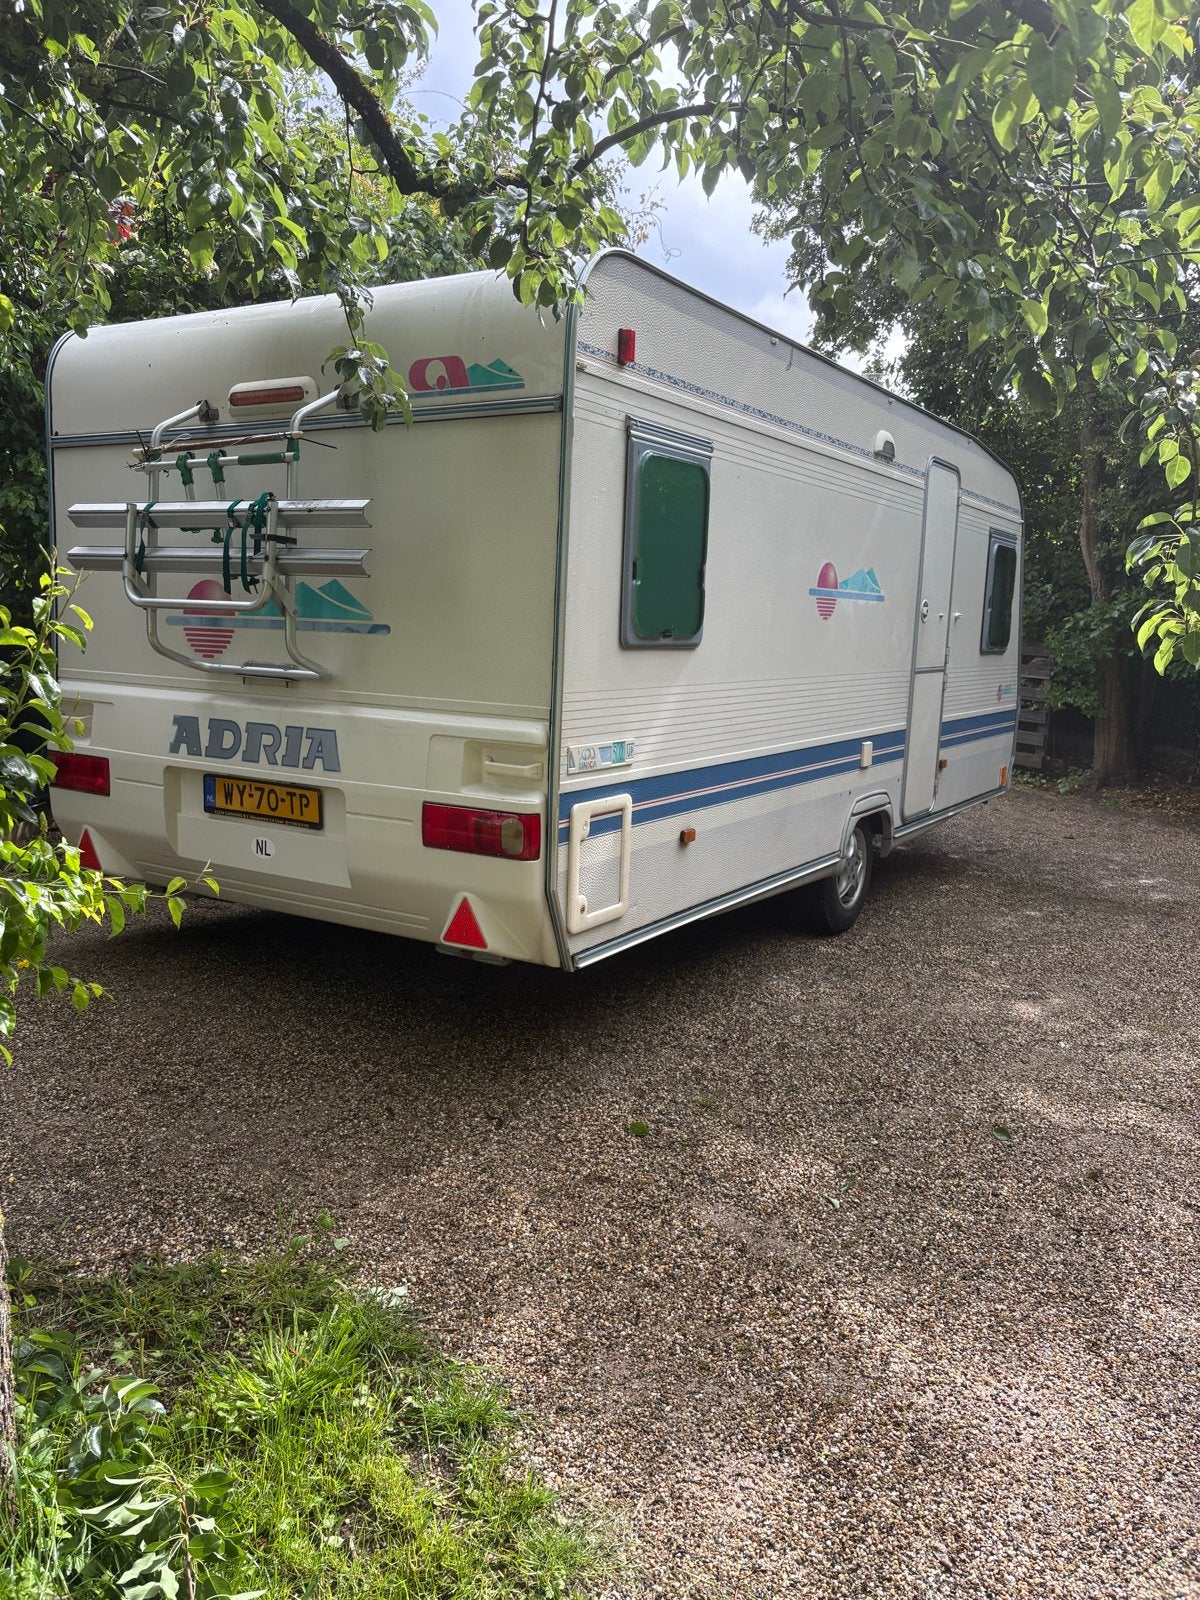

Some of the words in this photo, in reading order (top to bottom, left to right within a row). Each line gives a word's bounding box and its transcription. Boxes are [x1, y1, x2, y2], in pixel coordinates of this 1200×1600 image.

[169, 714, 342, 772] ADRIA
[206, 794, 215, 803] NL
[255, 838, 271, 857] NL
